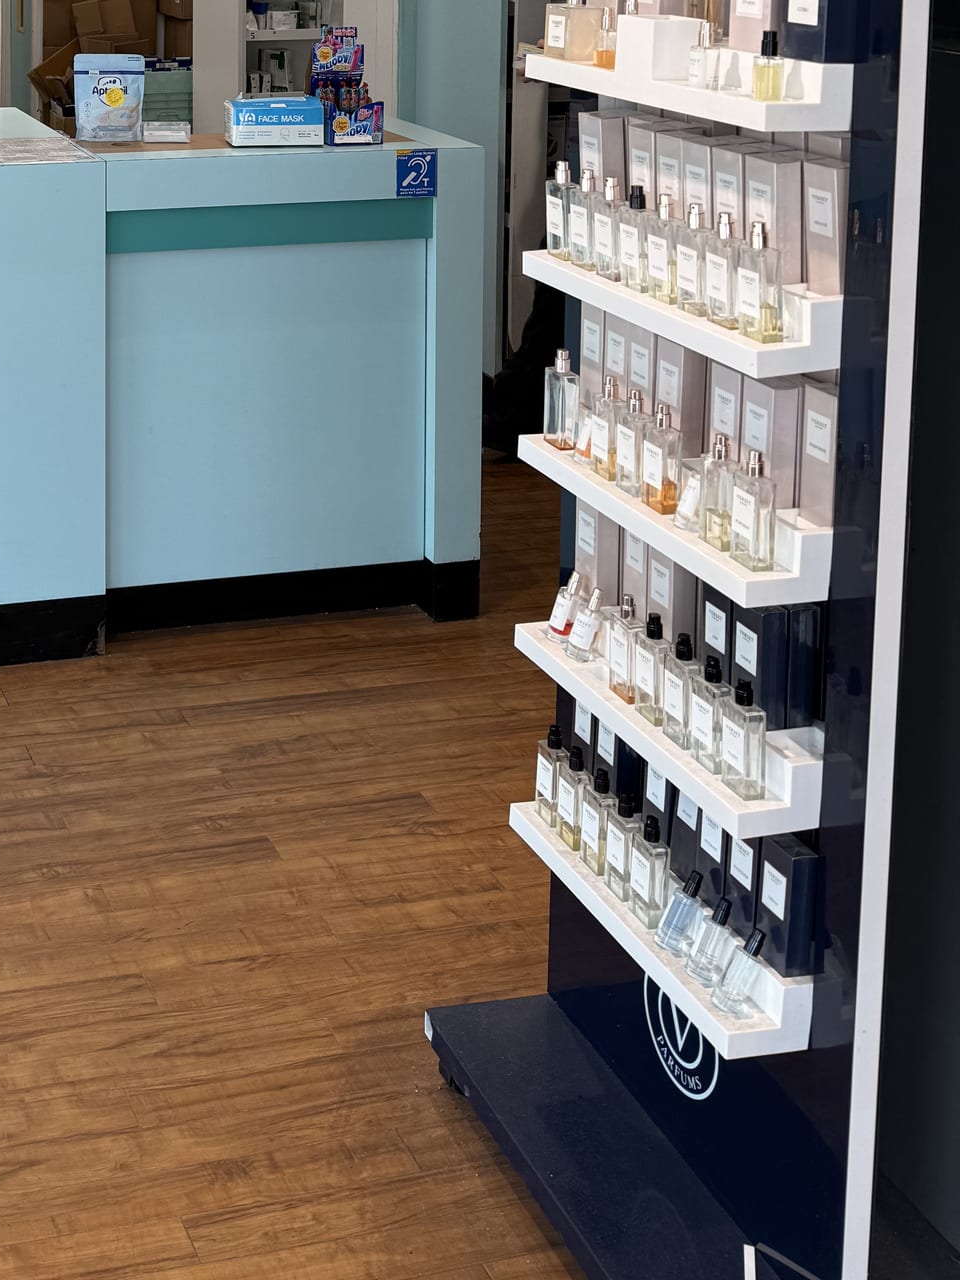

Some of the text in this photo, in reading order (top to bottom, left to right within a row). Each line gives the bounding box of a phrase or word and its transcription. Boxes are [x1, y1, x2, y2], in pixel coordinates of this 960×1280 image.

[319, 53, 351, 71] MELODY
[92, 86, 128, 96] Aptil
[258, 115, 279, 123] FACE
[422, 178, 430, 187] T
[657, 1035, 702, 1090] PARFUMS
